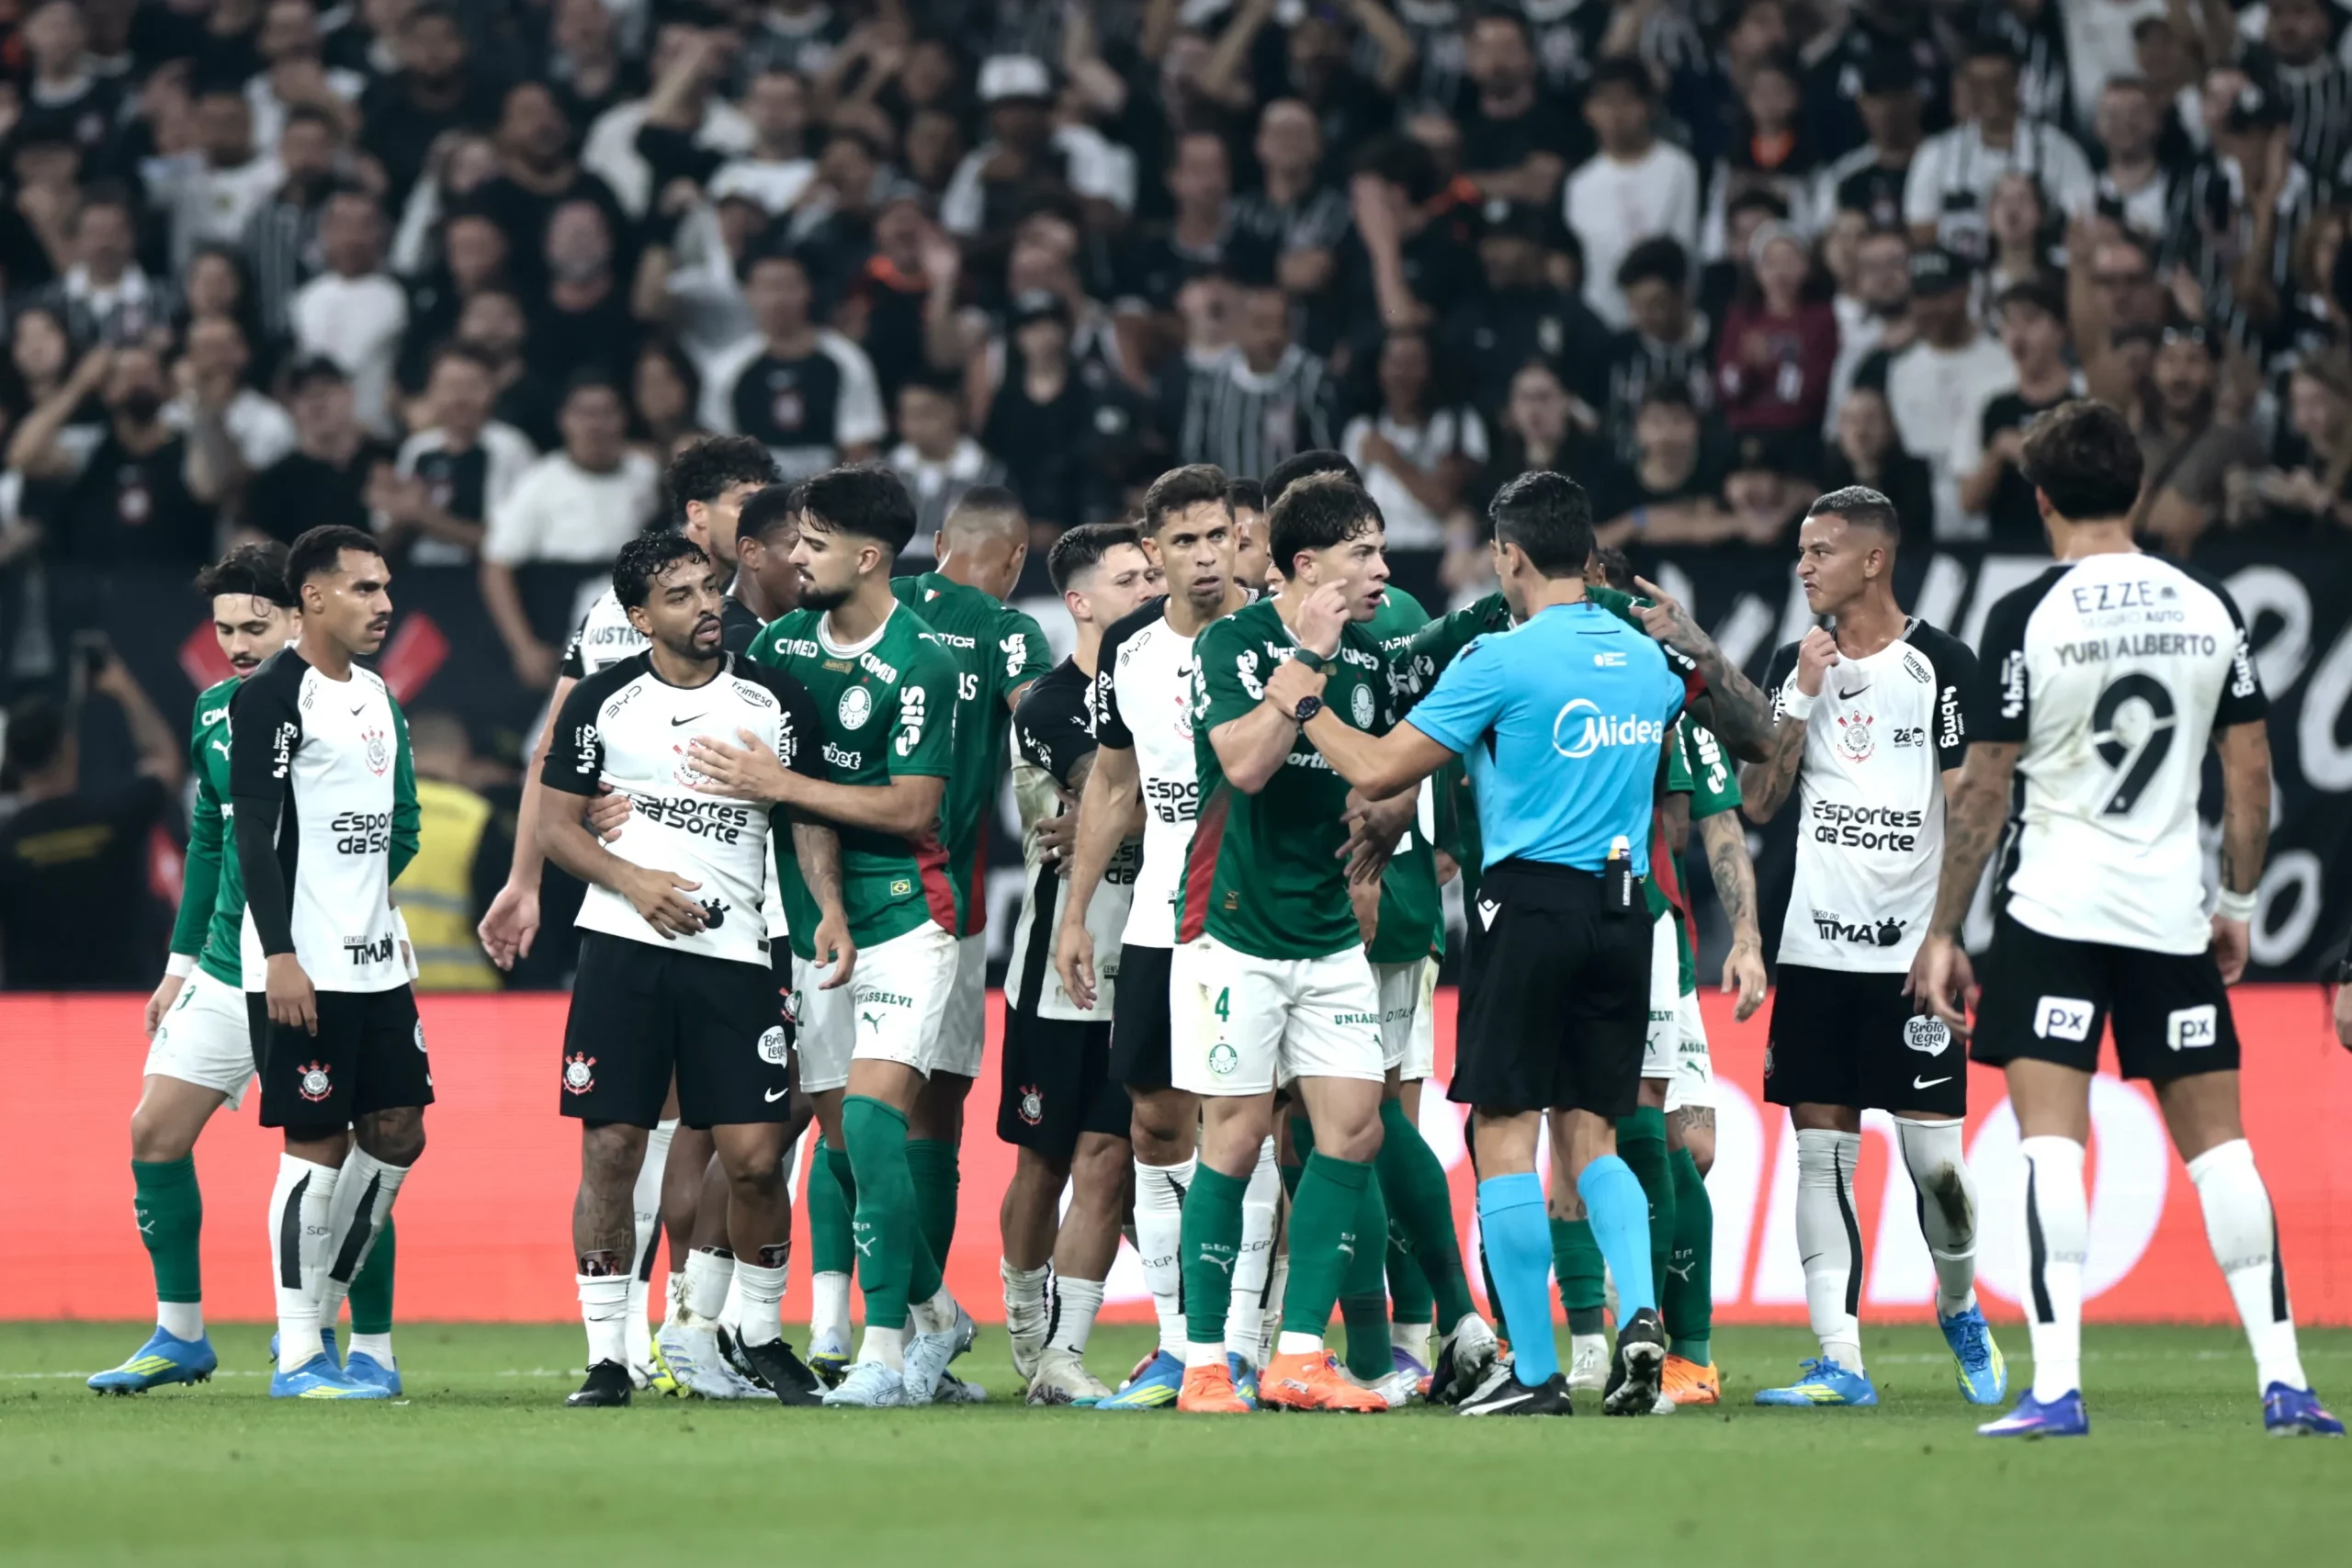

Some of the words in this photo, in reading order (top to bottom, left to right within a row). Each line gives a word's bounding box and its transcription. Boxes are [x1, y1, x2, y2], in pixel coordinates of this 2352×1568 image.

[2072, 581, 2154, 614] EZZE
[2144, 610, 2186, 623] AUTO
[588, 626, 651, 646] GUSTAV
[774, 637, 819, 659] CIMED
[2053, 637, 2110, 669] YURI
[2115, 632, 2217, 658] ALBERTO
[860, 651, 898, 685] CIMED
[1903, 650, 1932, 684] Frimesa
[731, 680, 774, 709] Frimesa
[201, 704, 231, 727] CIM
[1939, 701, 1961, 749] bmg
[1957, 712, 1966, 736] banco
[273, 727, 282, 750] banco
[274, 721, 299, 765] bmg
[1569, 712, 1664, 751] Midea
[1893, 728, 1912, 743] Zé
[2093, 671, 2177, 818] 9
[1146, 777, 1199, 805] Espo
[331, 812, 393, 836] Espor
[1812, 799, 1922, 829] Esportes
[663, 810, 740, 846] Sorte
[1841, 826, 1916, 852] Sorte
[337, 837, 367, 855] da
[1829, 913, 1840, 921] DO
[1103, 964, 1119, 975] CENS
[1214, 986, 1230, 1023] 4
[1334, 1013, 1381, 1026] UNIASS
[2047, 1009, 2085, 1037] px
[763, 1032, 785, 1048] Bro
[2180, 1020, 2211, 1045] px
[767, 1045, 786, 1061] Leg
[1238, 1239, 1271, 1253] CCP
